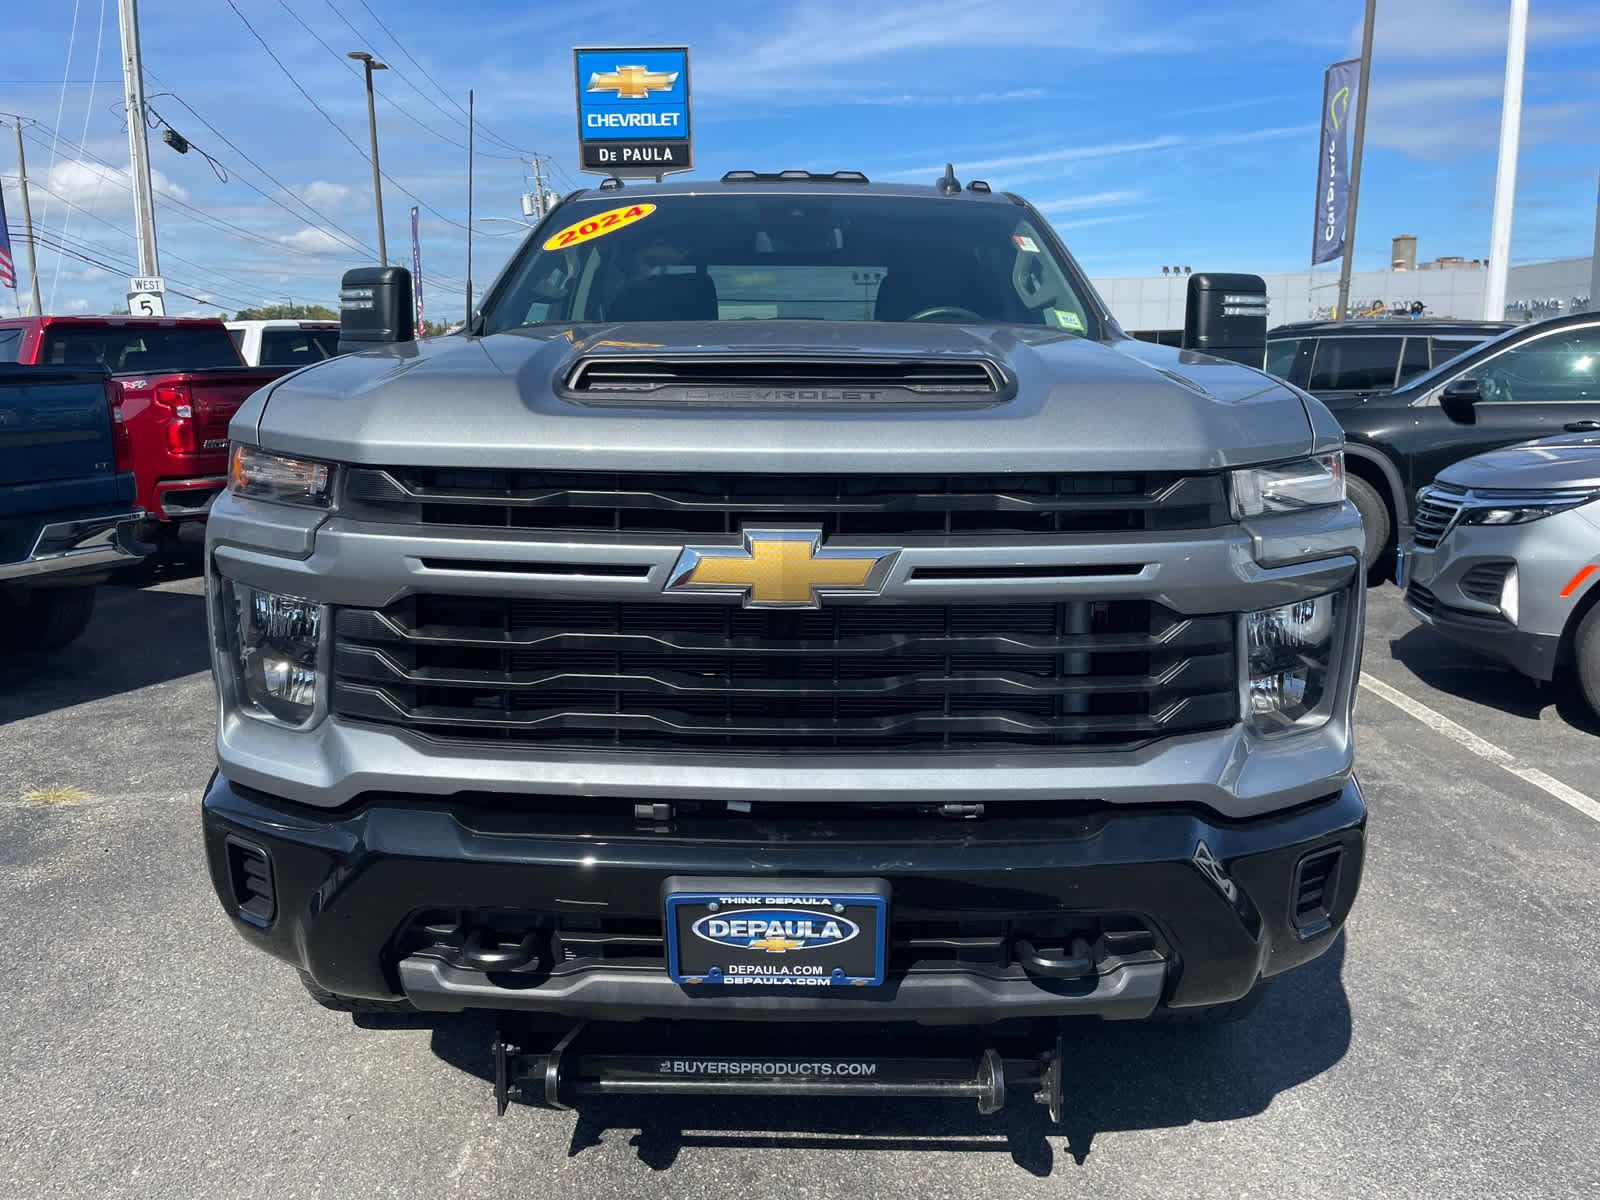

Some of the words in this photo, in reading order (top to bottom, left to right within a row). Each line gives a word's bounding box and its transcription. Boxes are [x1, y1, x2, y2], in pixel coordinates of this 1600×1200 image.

[587, 112, 681, 127] CHEVROLET
[623, 147, 673, 161] PAULA
[556, 206, 646, 247] 2024
[134, 279, 161, 290] WEST
[140, 300, 154, 316] 5
[719, 897, 762, 905] THINK
[765, 897, 832, 906] DEPAULA
[708, 919, 843, 938] DEPAULA
[728, 965, 824, 975] DEPAULA.COM
[723, 977, 831, 986] DEPAULA.COM
[673, 1061, 876, 1075] BUYERSPRODUCTS.COM
